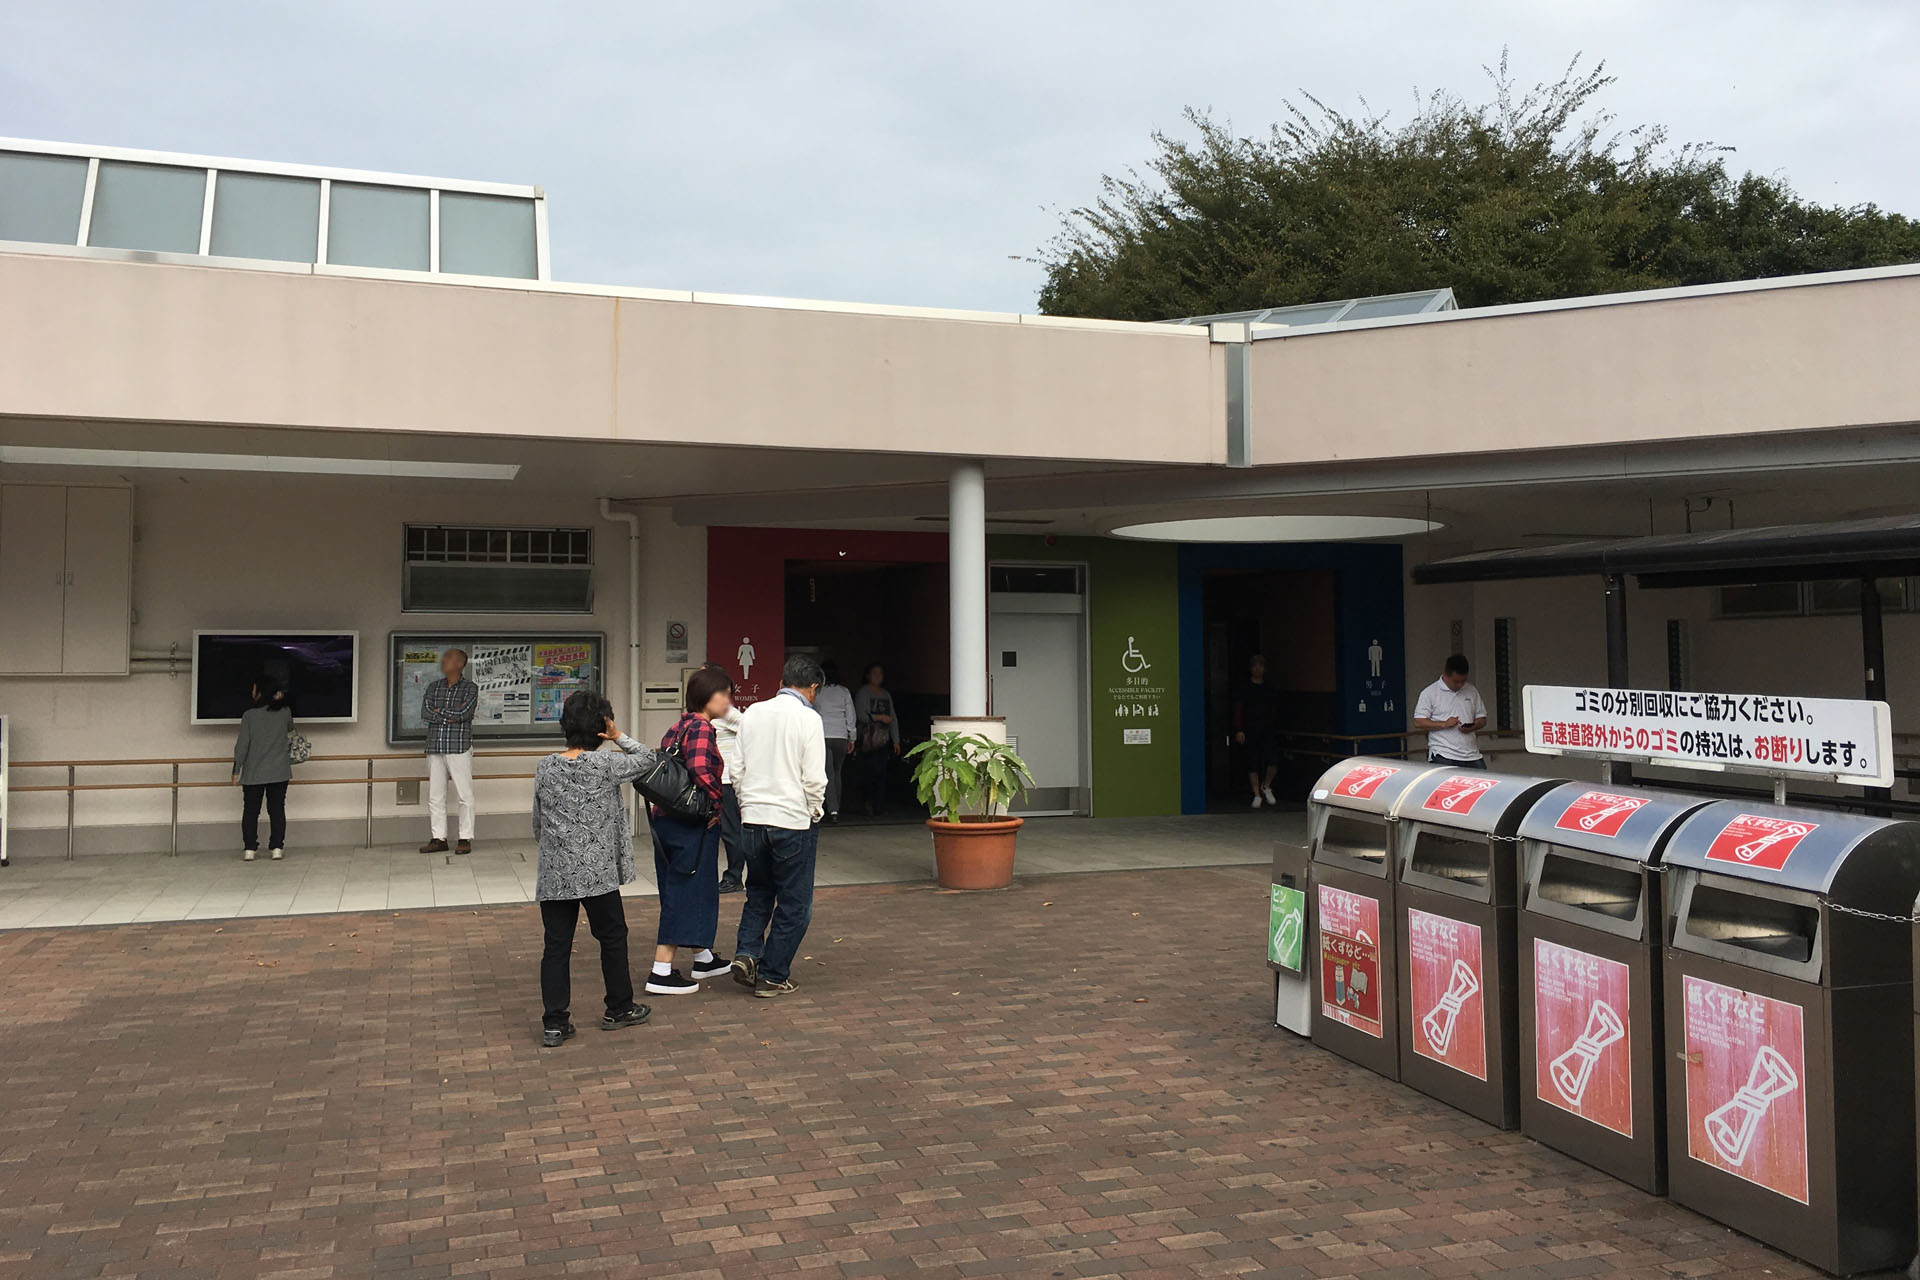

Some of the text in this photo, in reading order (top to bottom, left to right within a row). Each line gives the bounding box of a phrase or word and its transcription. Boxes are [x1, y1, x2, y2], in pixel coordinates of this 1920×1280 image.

[734, 684, 759, 693] 女子
[1126, 677, 1149, 686] 多目的
[1575, 689, 1814, 725] ゴミの分別回収にご協力ください。
[1541, 721, 1868, 769] 高速道路外からのゴミの持込は、お断りします。
[1734, 815, 1788, 830] 紙くずなど
[1273, 888, 1287, 904] ビン
[1321, 889, 1361, 915] 紙くずなど
[1411, 913, 1459, 943] 紙くずなど
[1538, 943, 1599, 981] 紙くずなど
[1687, 983, 1765, 1025] 紙くずなど
